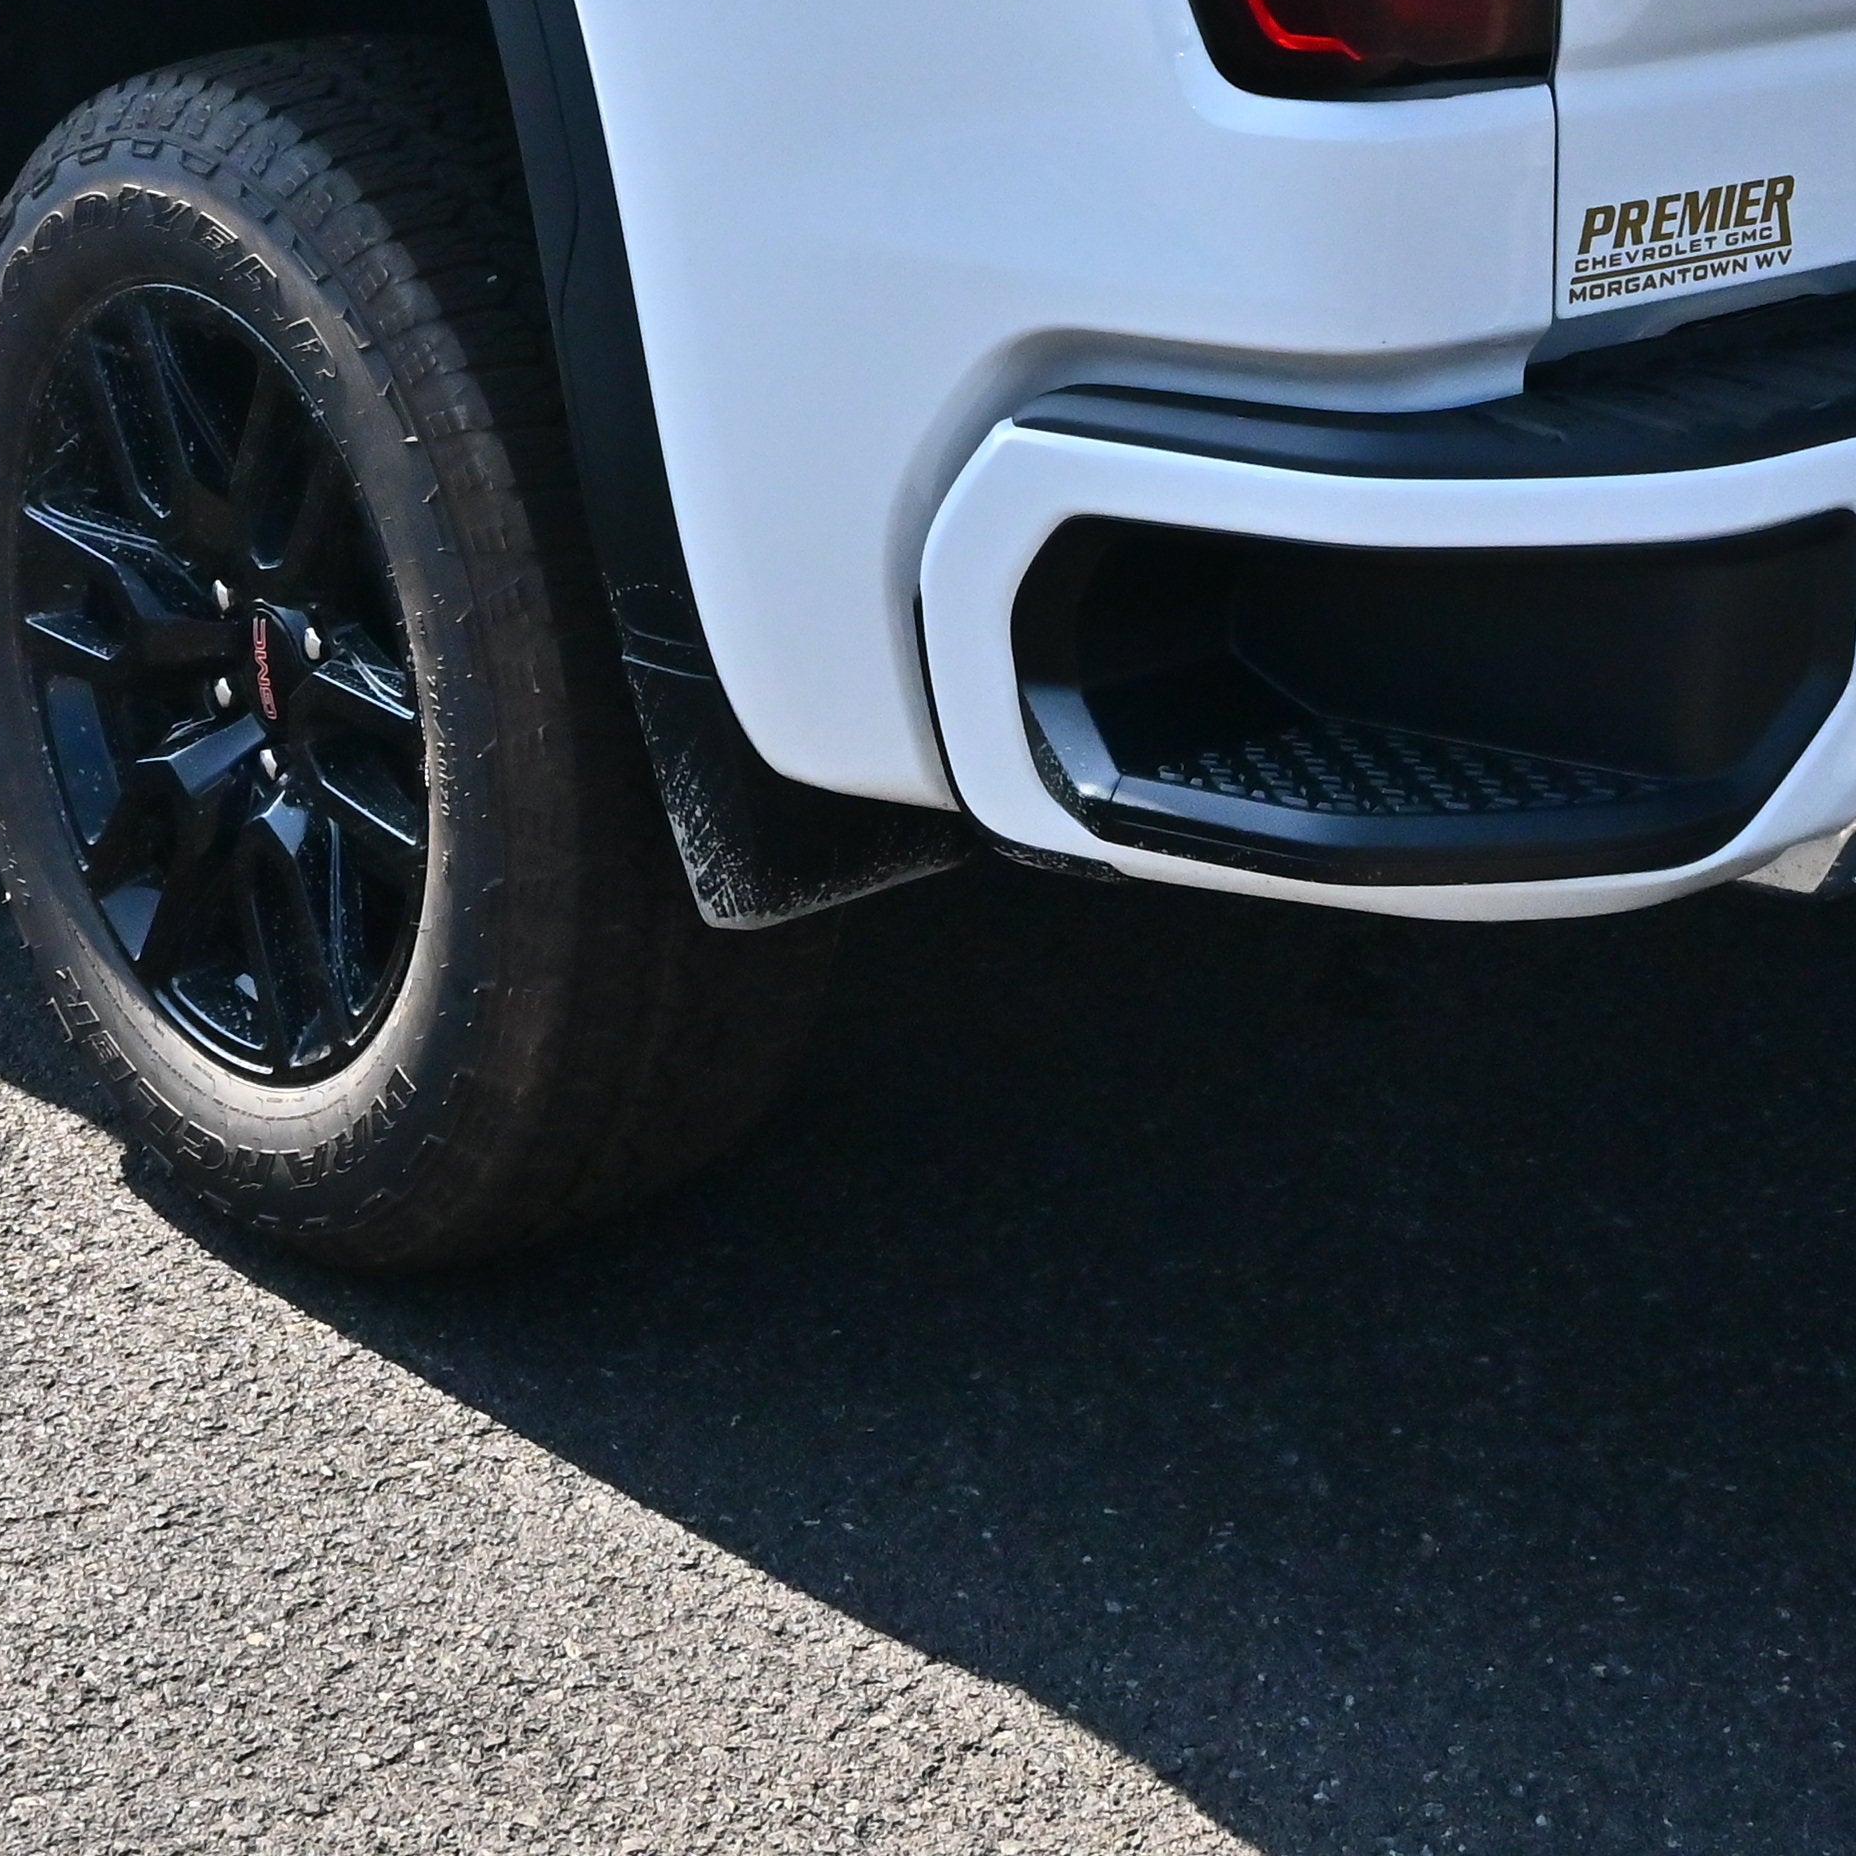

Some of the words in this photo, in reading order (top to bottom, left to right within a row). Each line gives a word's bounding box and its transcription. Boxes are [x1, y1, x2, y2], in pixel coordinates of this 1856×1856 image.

[1574, 235, 1718, 274] CHEVROLET
[1724, 226, 1774, 247] GMC
[1577, 174, 1795, 256] PREMIER
[1568, 257, 1749, 305] MORGANTOWN
[1755, 247, 1793, 271] WV
[252, 616, 278, 720] GMC
